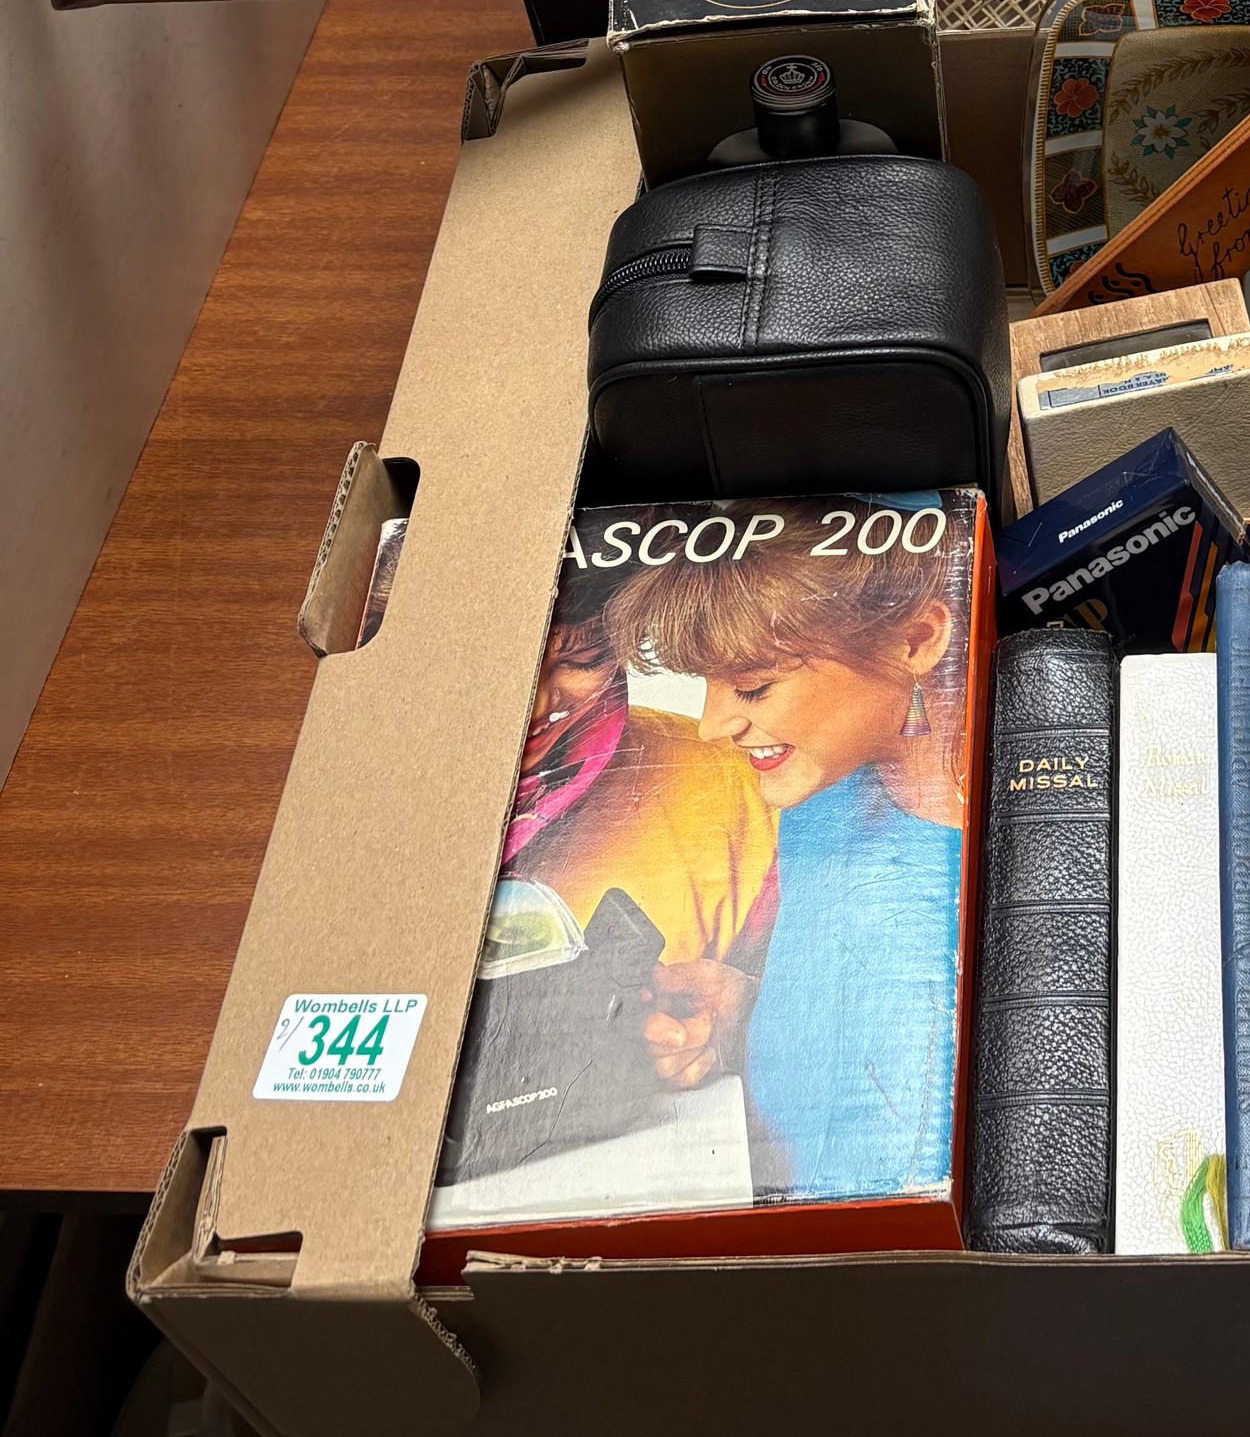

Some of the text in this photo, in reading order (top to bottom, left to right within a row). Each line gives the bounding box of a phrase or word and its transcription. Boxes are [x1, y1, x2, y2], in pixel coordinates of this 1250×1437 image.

[1057, 499, 1125, 544] Panasonic
[809, 508, 947, 557] 200
[1021, 506, 1196, 615] Panasonic
[1018, 756, 1090, 774] DAILY
[1009, 774, 1099, 792] MISSAL
[294, 999, 418, 1014] Wombells LLP
[298, 1014, 390, 1066] 344
[287, 1067, 382, 1080] Tel: 01904 790777
[273, 1081, 386, 1095] www.wombells.co.uk
[536, 1087, 558, 1101] 200
